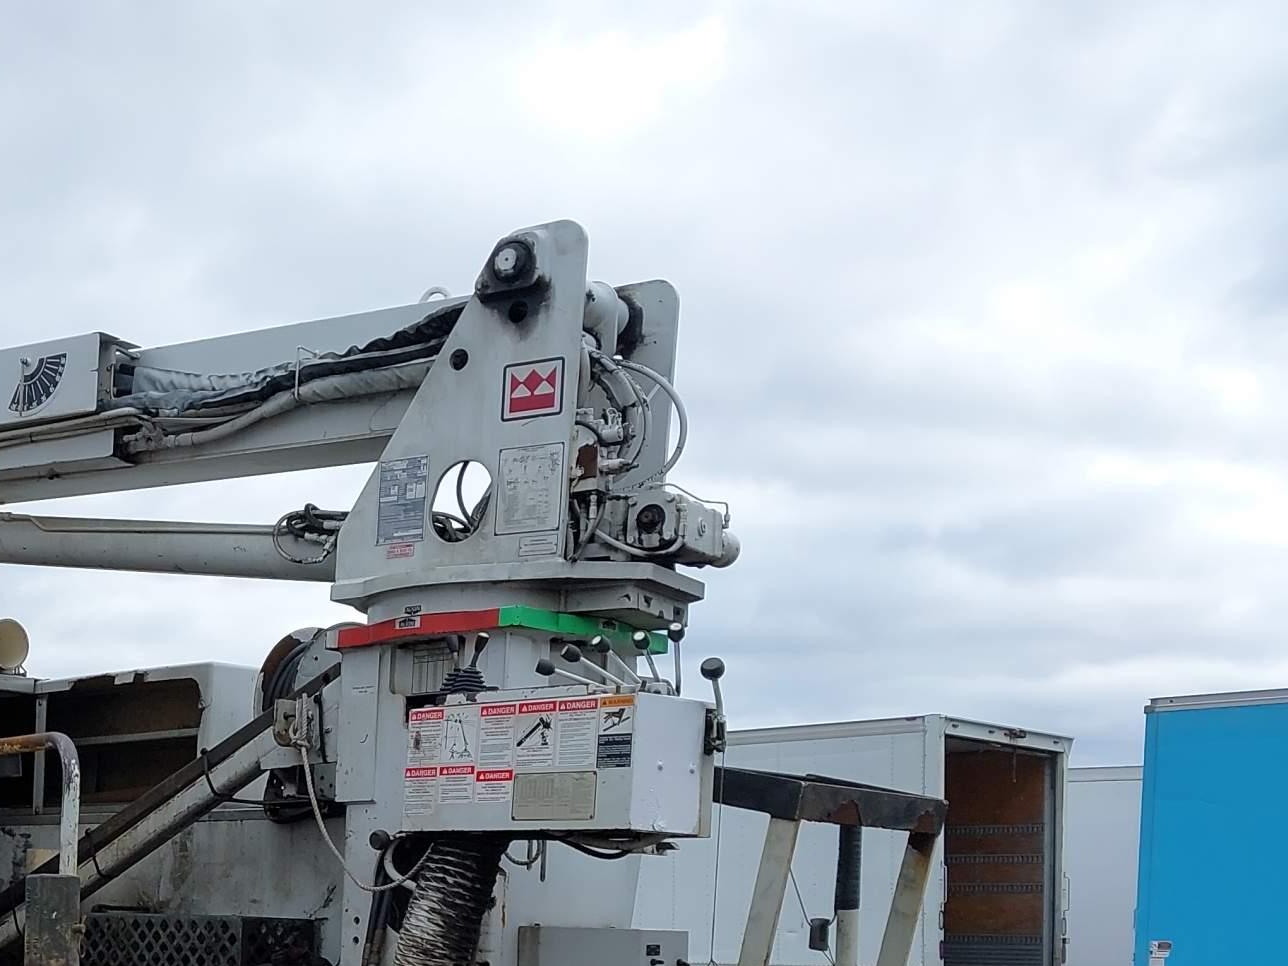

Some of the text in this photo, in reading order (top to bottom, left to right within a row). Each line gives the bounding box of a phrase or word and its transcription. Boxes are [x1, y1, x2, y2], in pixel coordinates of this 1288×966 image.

[528, 703, 554, 711] DANGER
[567, 700, 596, 709] DANGER
[488, 706, 515, 714] DANGER
[417, 711, 443, 720] DANGER
[411, 769, 436, 777] DANGER
[485, 772, 510, 780] DANGER
